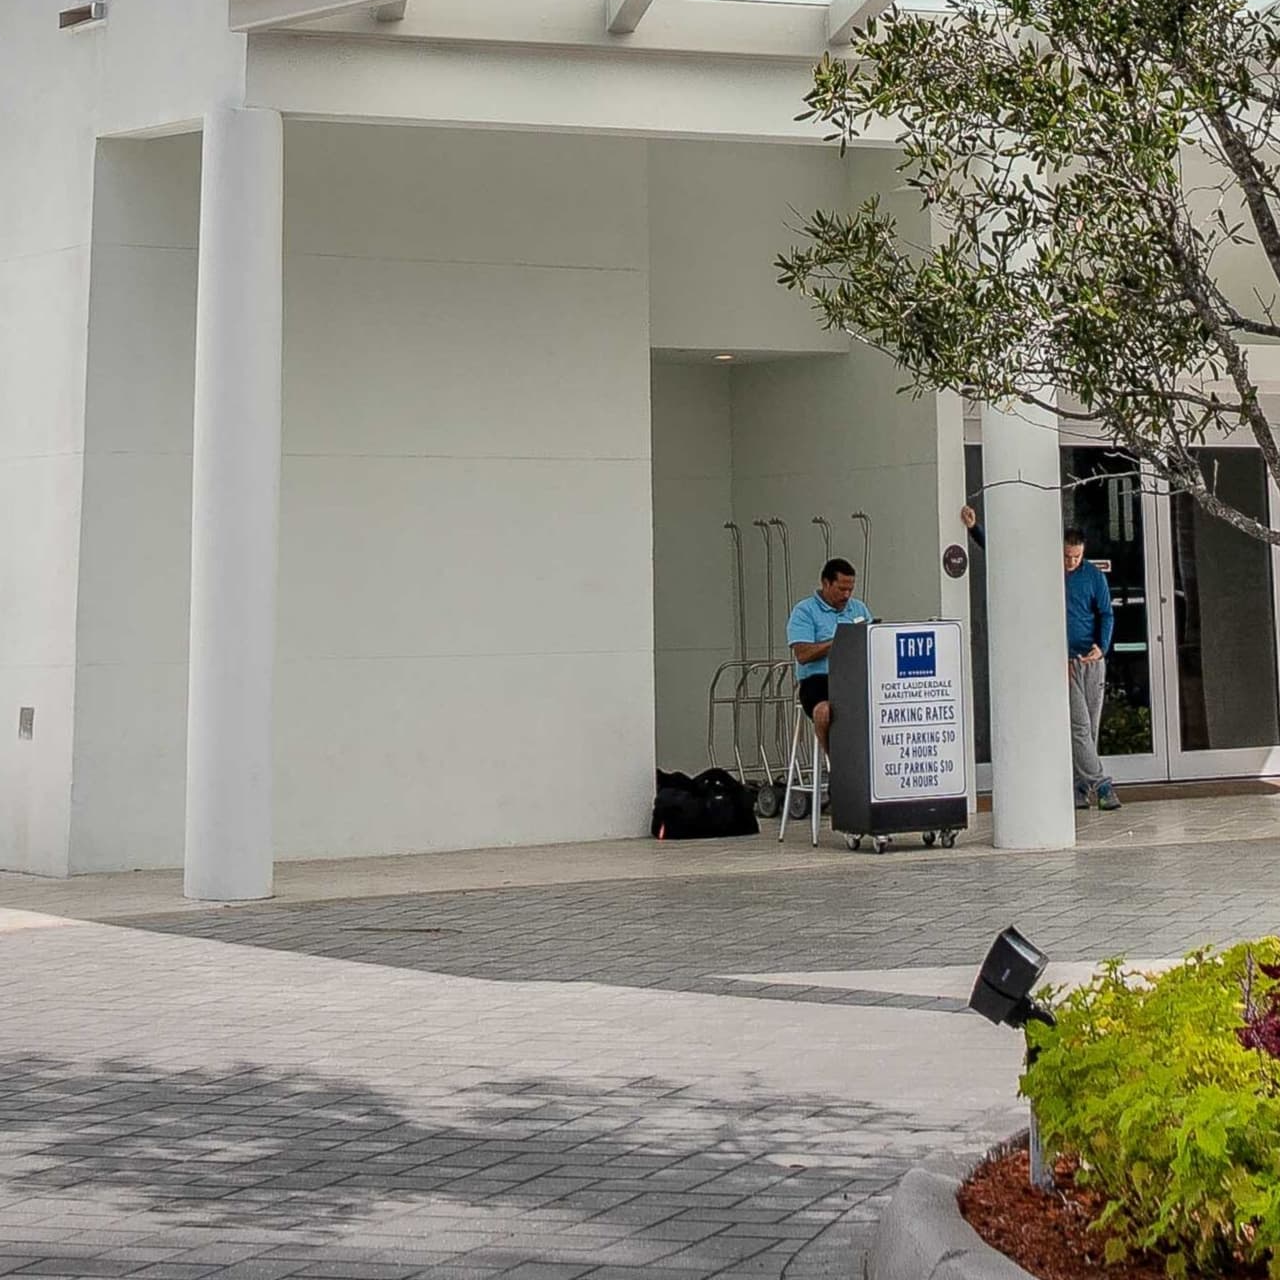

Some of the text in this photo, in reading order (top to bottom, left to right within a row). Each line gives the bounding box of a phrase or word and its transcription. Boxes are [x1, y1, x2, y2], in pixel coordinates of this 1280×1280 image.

[899, 637, 934, 657] TRYP
[881, 680, 952, 691] FORT LAUDERDALE
[884, 689, 950, 699] MARITIME HOTEL
[881, 705, 954, 723] PARKING RATES
[881, 732, 904, 746] VALET
[906, 731, 940, 744] PARKING
[900, 745, 938, 759] 24 HOURS
[885, 763, 902, 776] SELF
[904, 761, 938, 774] PARKING
[901, 775, 939, 789] 24 HOURS
